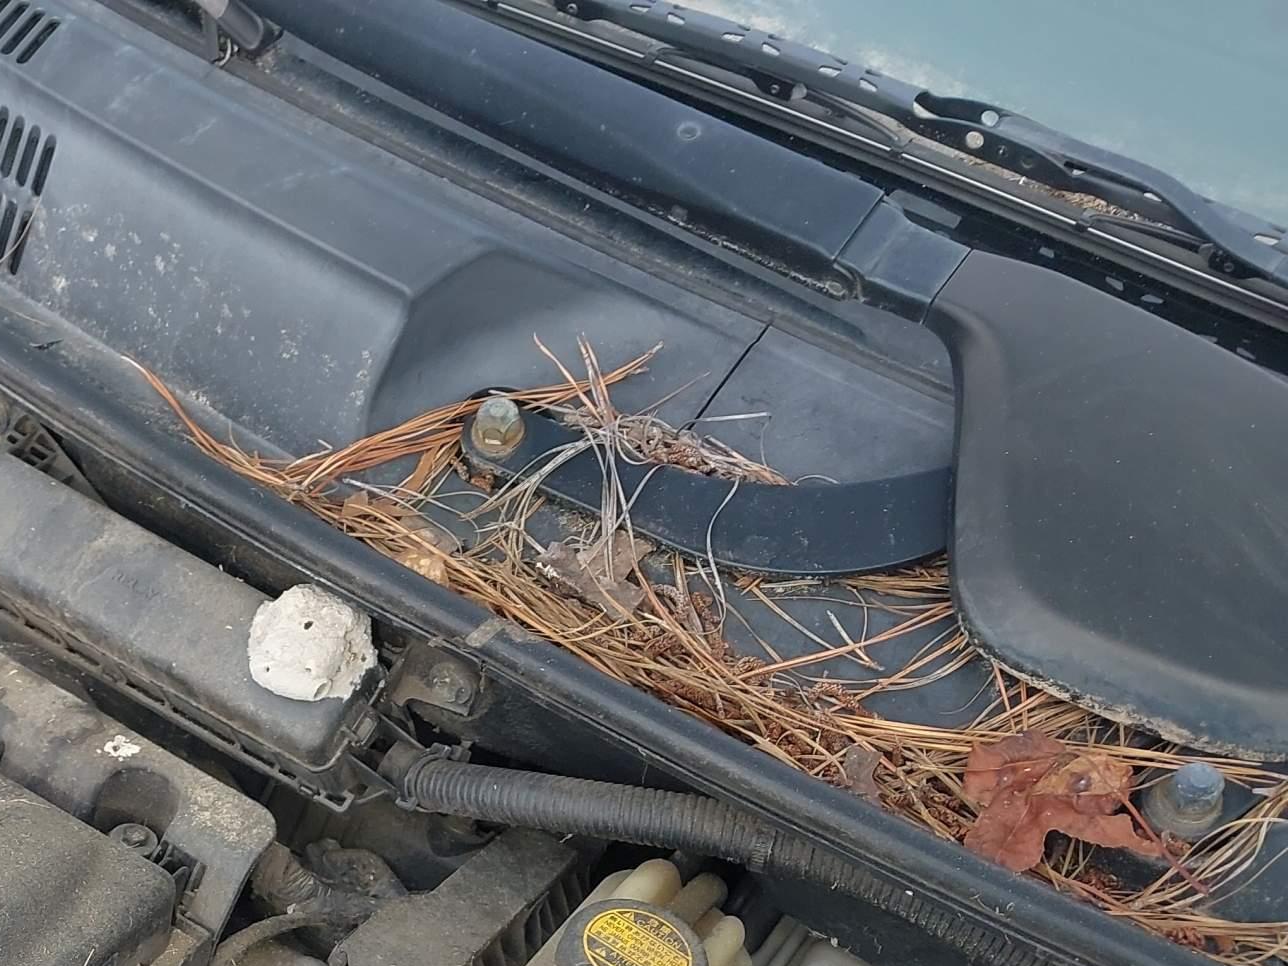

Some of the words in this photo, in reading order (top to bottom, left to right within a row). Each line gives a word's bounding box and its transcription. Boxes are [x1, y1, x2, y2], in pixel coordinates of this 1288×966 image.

[605, 920, 624, 934] NEVER
[627, 933, 644, 947] OPEN
[647, 945, 664, 960] WHEN
[637, 920, 682, 950] CAUTION
